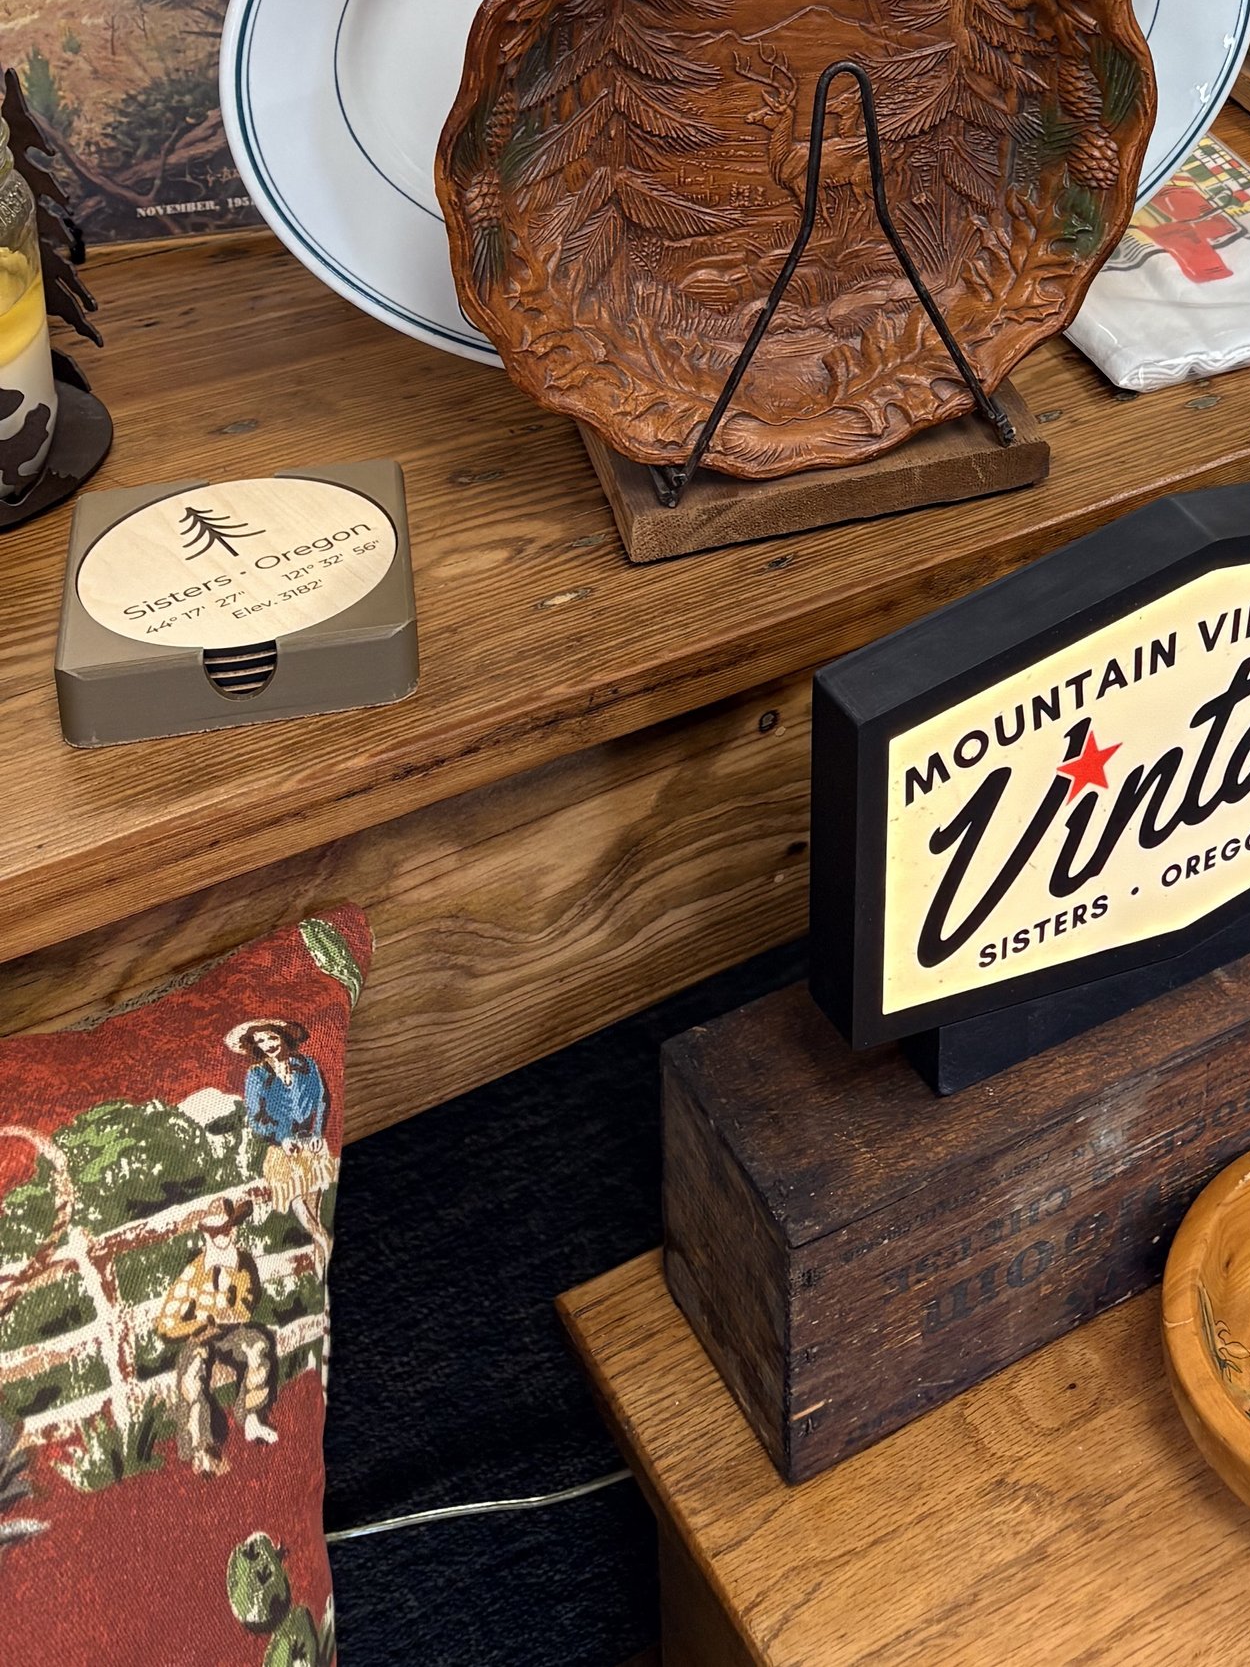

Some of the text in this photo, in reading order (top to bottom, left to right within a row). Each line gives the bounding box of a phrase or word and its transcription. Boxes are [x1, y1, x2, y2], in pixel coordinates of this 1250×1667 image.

[136, 200, 220, 218] NOVEMBER,
[123, 522, 372, 621] Sisters Oregon
[146, 540, 380, 634] 44° 17' 27" 121° 32' 56"
[231, 579, 323, 620] Elev. 3182'
[903, 632, 1178, 809] MOUNTAIN
[978, 895, 1110, 969] SISTERS
